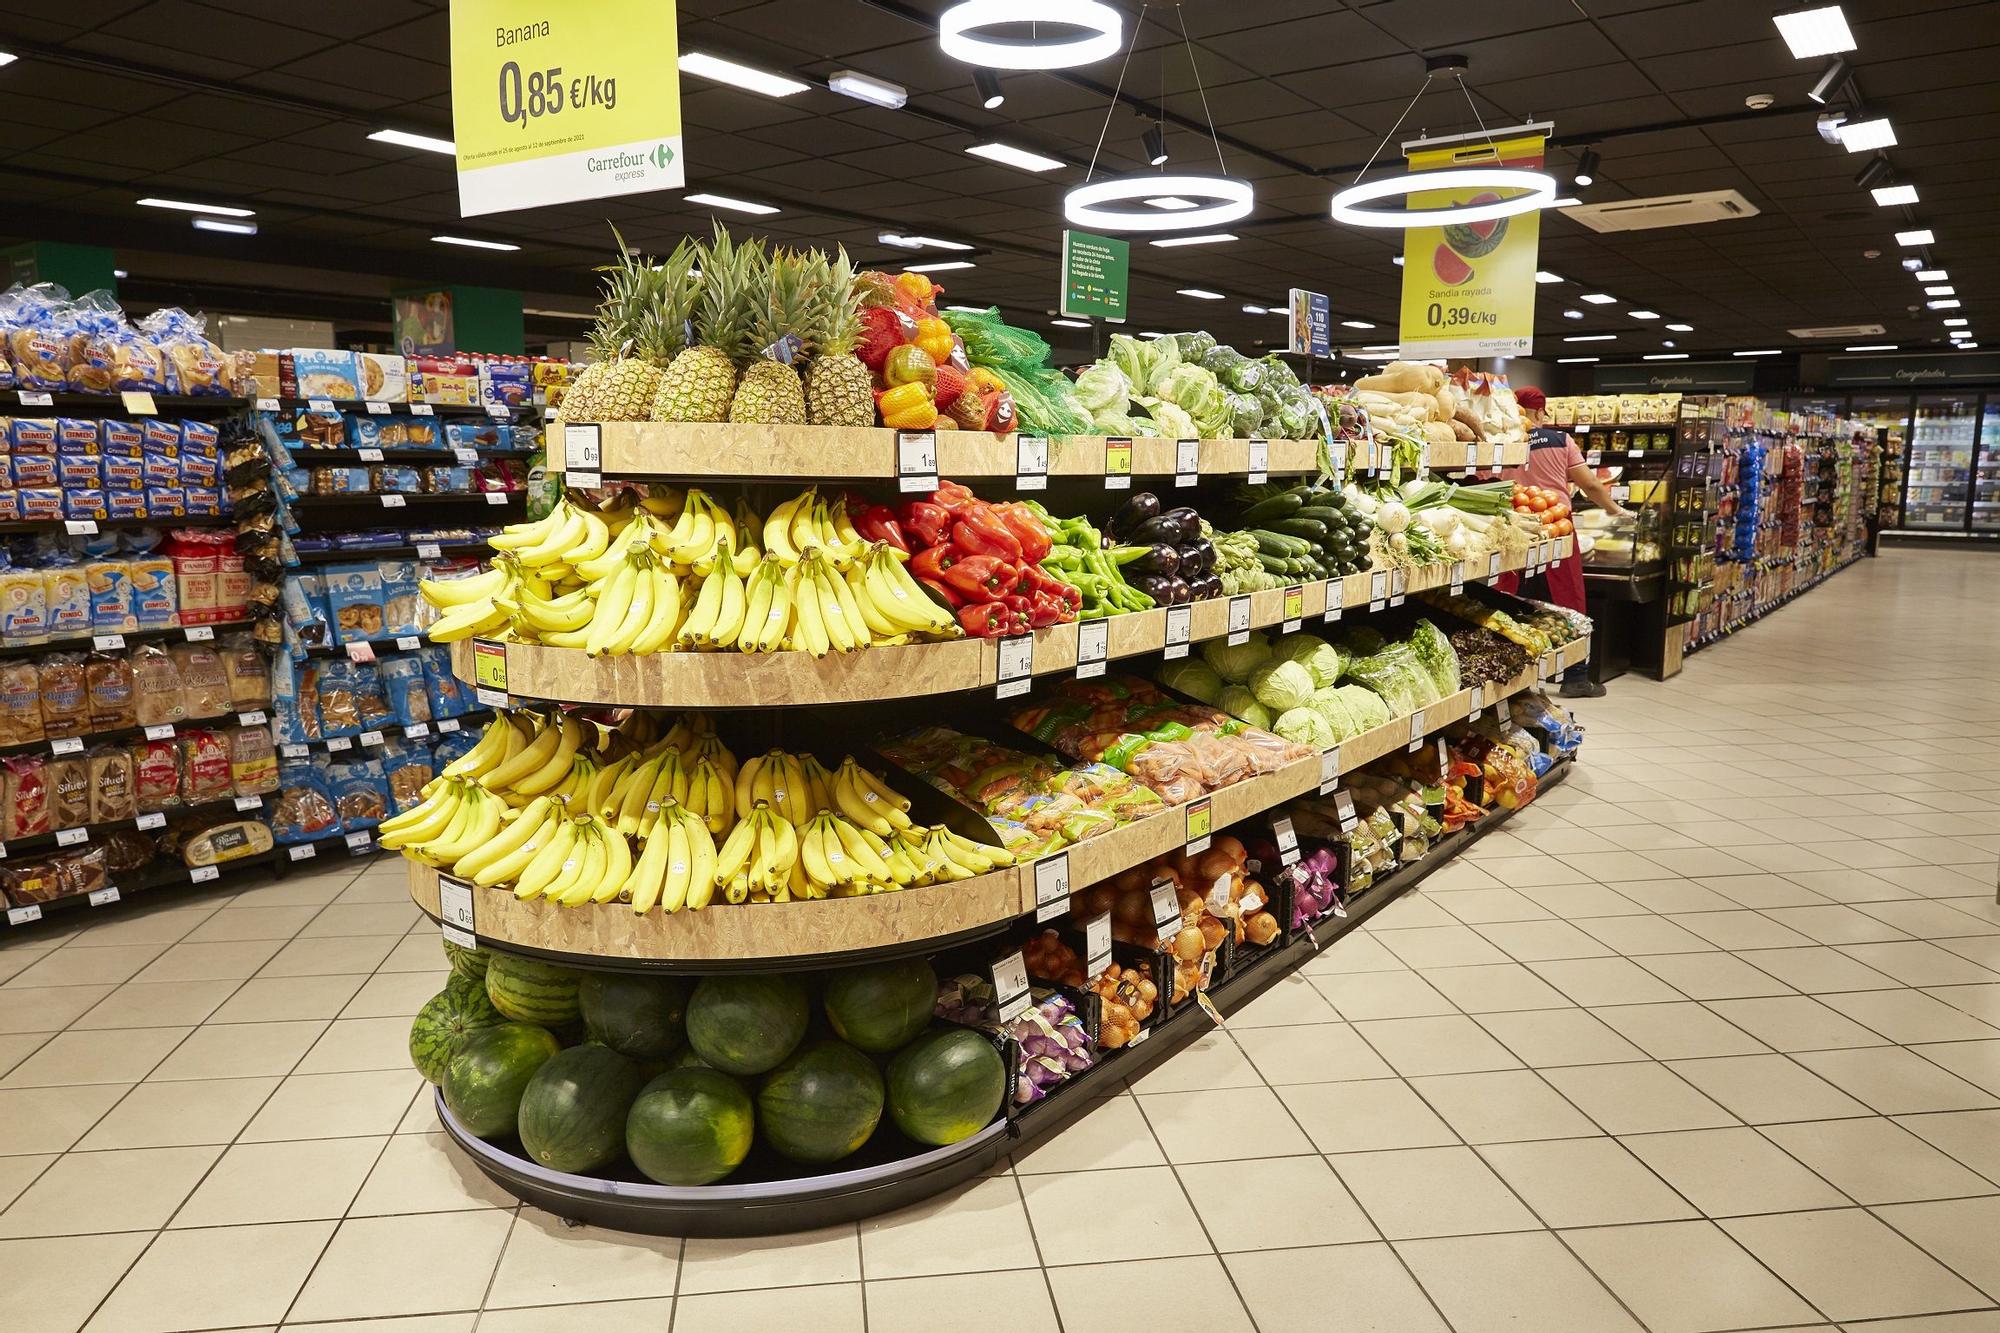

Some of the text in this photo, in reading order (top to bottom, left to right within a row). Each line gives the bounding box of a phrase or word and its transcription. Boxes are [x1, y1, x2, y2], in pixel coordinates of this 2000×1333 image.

[495, 20, 550, 48] Banana
[498, 60, 617, 130] 0,85 €/kg
[587, 152, 645, 173] Carrefour
[614, 169, 645, 182] express
[1460, 286, 1492, 298] rayada
[1427, 303, 1497, 328] 0,39 €/kg
[21, 432, 52, 440] BIMBO
[66, 431, 94, 440] BIMBO
[112, 434, 140, 442] BIMBO
[150, 430, 176, 442] BIMBO
[189, 432, 216, 442] BIMBO
[144, 442, 164, 451] Grande
[184, 444, 204, 452] Grande
[20, 464, 50, 473] BIMBO
[66, 466, 96, 474] BIMBO
[111, 467, 140, 475] BIMBO
[150, 466, 177, 474] BIMBO
[187, 464, 214, 473] BIMBO
[107, 480, 130, 488] Grande
[144, 478, 166, 486] Grande
[182, 476, 203, 484] Grande
[73, 498, 102, 506] BIMBO
[115, 496, 143, 505] BIMBO
[154, 495, 182, 504] BIMBO
[192, 494, 218, 502] BIMBO
[28, 500, 58, 508] BIMBO
[70, 512, 93, 520] Grande
[188, 508, 208, 516] Grande
[60, 610, 84, 619] BIMBO
[14, 616, 40, 625] BIMBO
[98, 772, 126, 787] Siluet
[56, 779, 88, 795] Siluet
